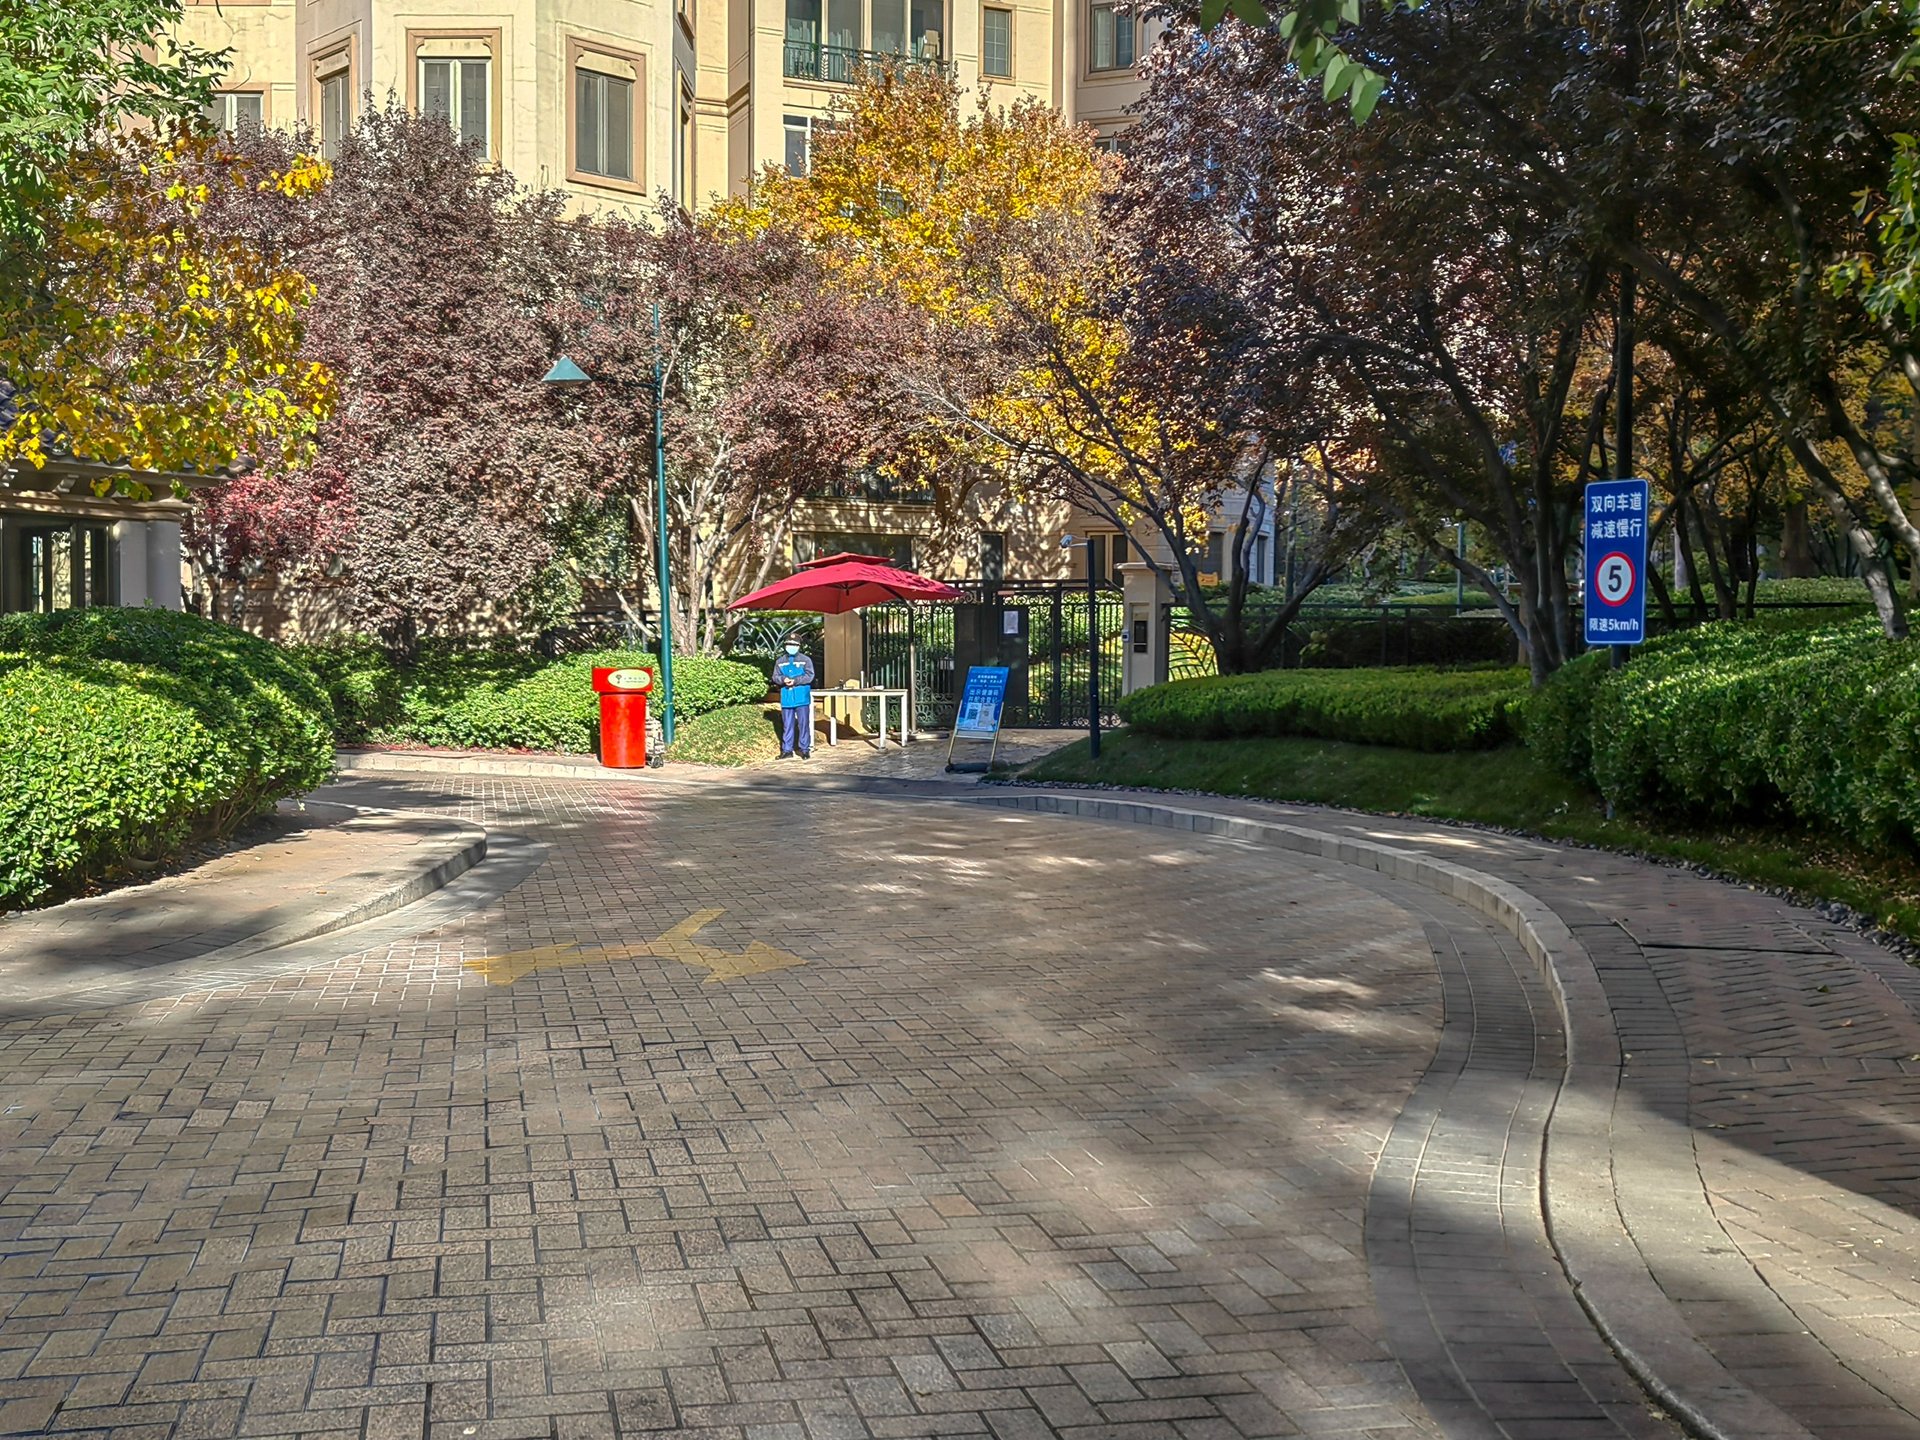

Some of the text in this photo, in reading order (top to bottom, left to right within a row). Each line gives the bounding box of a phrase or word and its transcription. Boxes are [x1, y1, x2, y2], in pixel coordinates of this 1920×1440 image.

[1590, 491, 1642, 513] 双向车道
[1590, 518, 1642, 539] 减速慢行
[1607, 565, 1622, 593] 5
[1589, 617, 1639, 632] 限速5km/h
